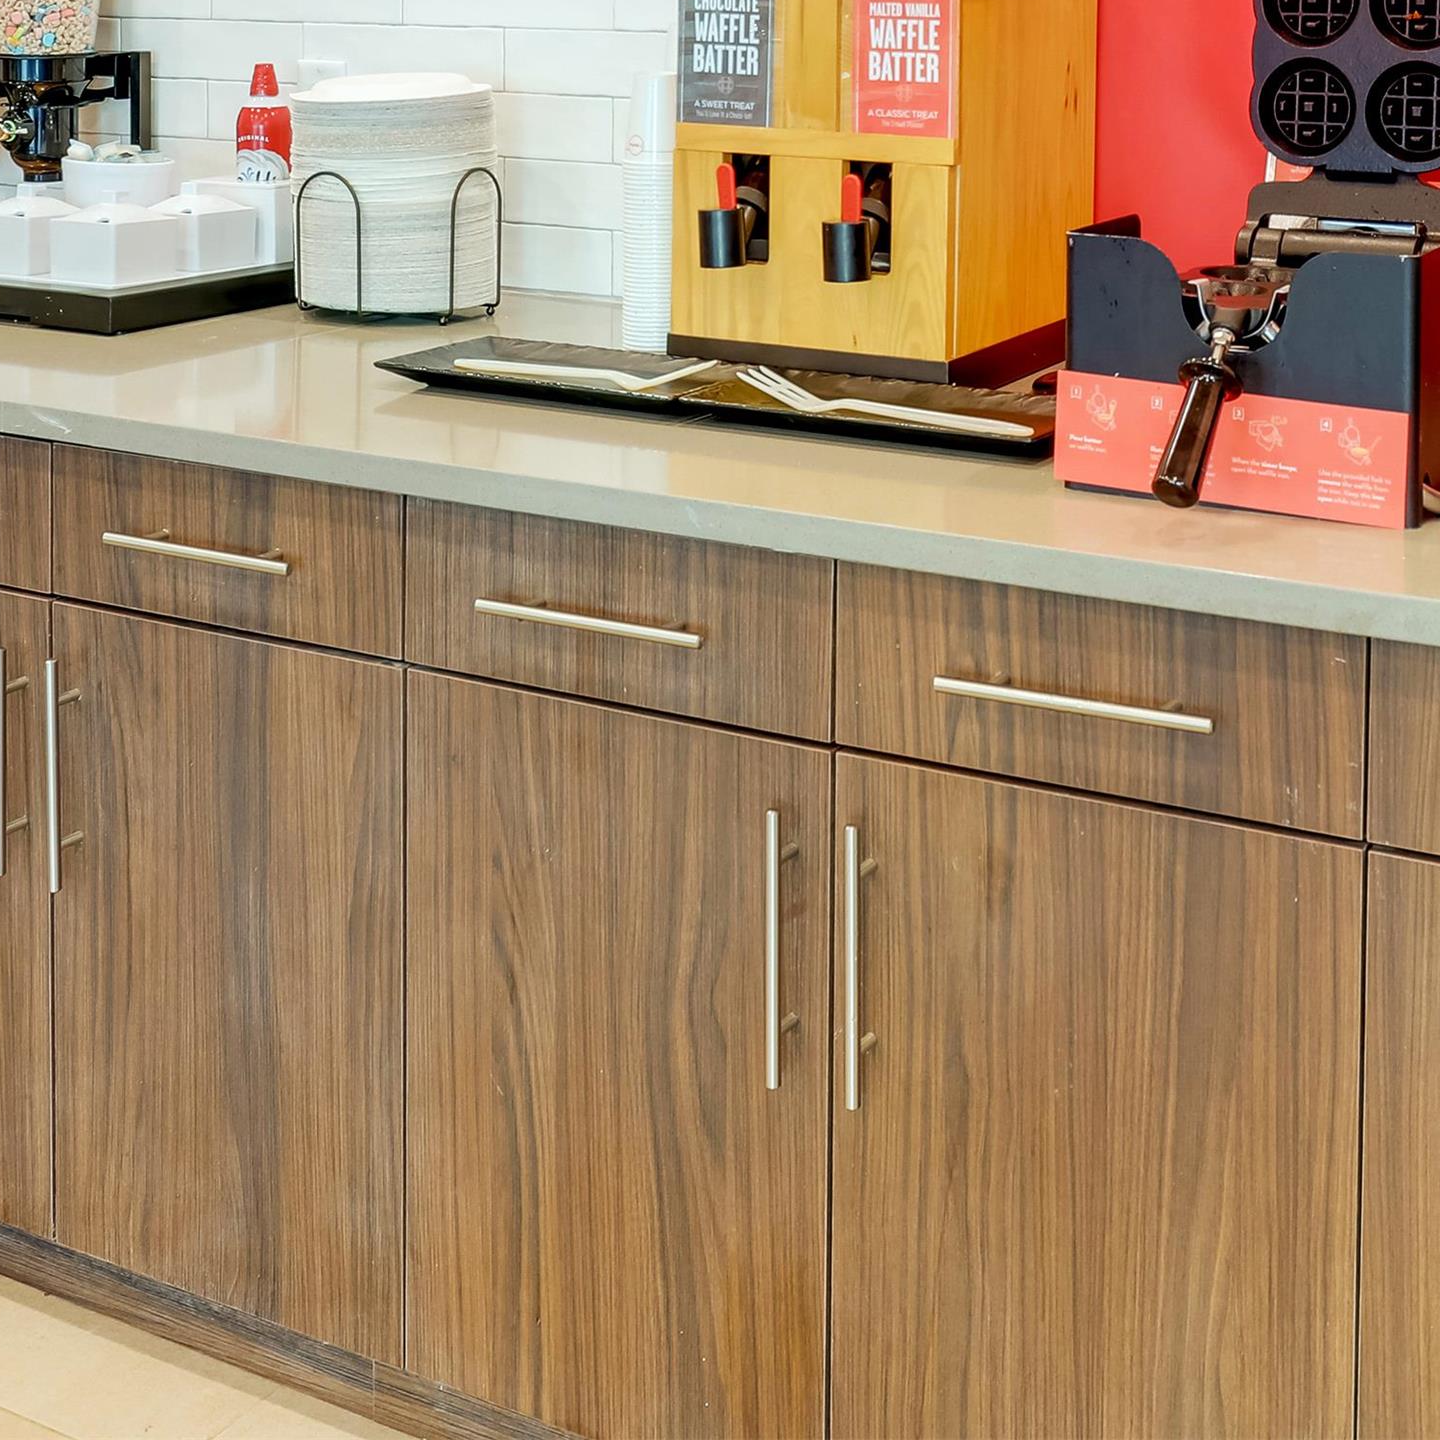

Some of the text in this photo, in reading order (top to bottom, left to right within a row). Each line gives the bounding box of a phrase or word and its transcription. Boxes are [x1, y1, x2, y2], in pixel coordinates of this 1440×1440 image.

[869, 2, 940, 18] MALTED VANILLA
[694, 12, 760, 44] WAFFLE
[870, 18, 940, 51] WAFFLE
[693, 43, 759, 76] BATTER
[868, 51, 940, 83] BATTER
[702, 101, 728, 110] SWEET
[730, 102, 756, 111] TREAT
[868, 109, 938, 120] A CLASSIC TREAT
